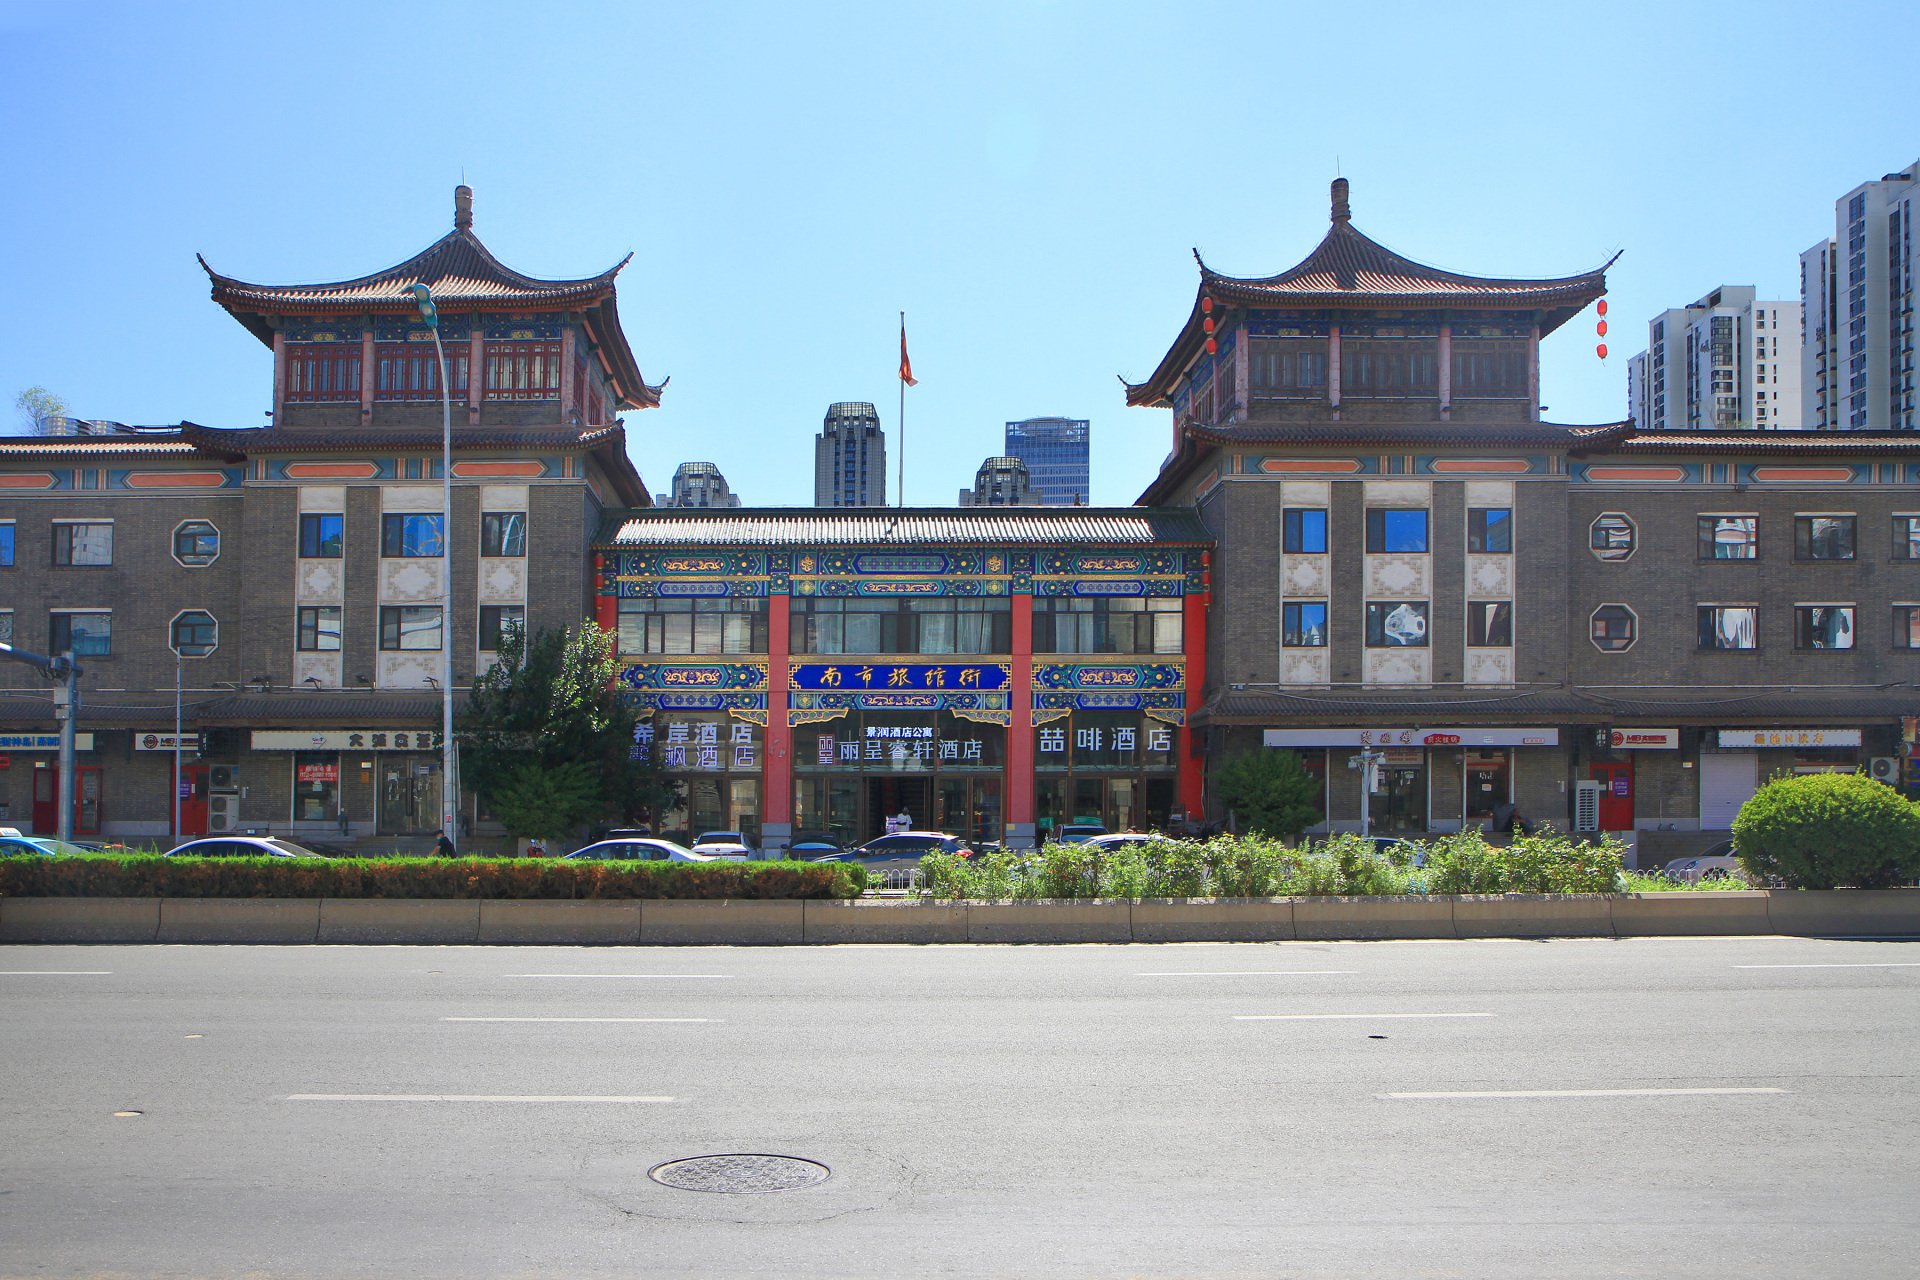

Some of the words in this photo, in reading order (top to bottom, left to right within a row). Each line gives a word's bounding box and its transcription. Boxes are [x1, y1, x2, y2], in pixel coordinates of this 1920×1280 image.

[632, 721, 754, 746] 希岸酒店
[865, 726, 933, 738] 景润酒店公寓
[1039, 727, 1172, 752] 喆啡酒店
[840, 739, 984, 761] 丽呈睿轩酒店
